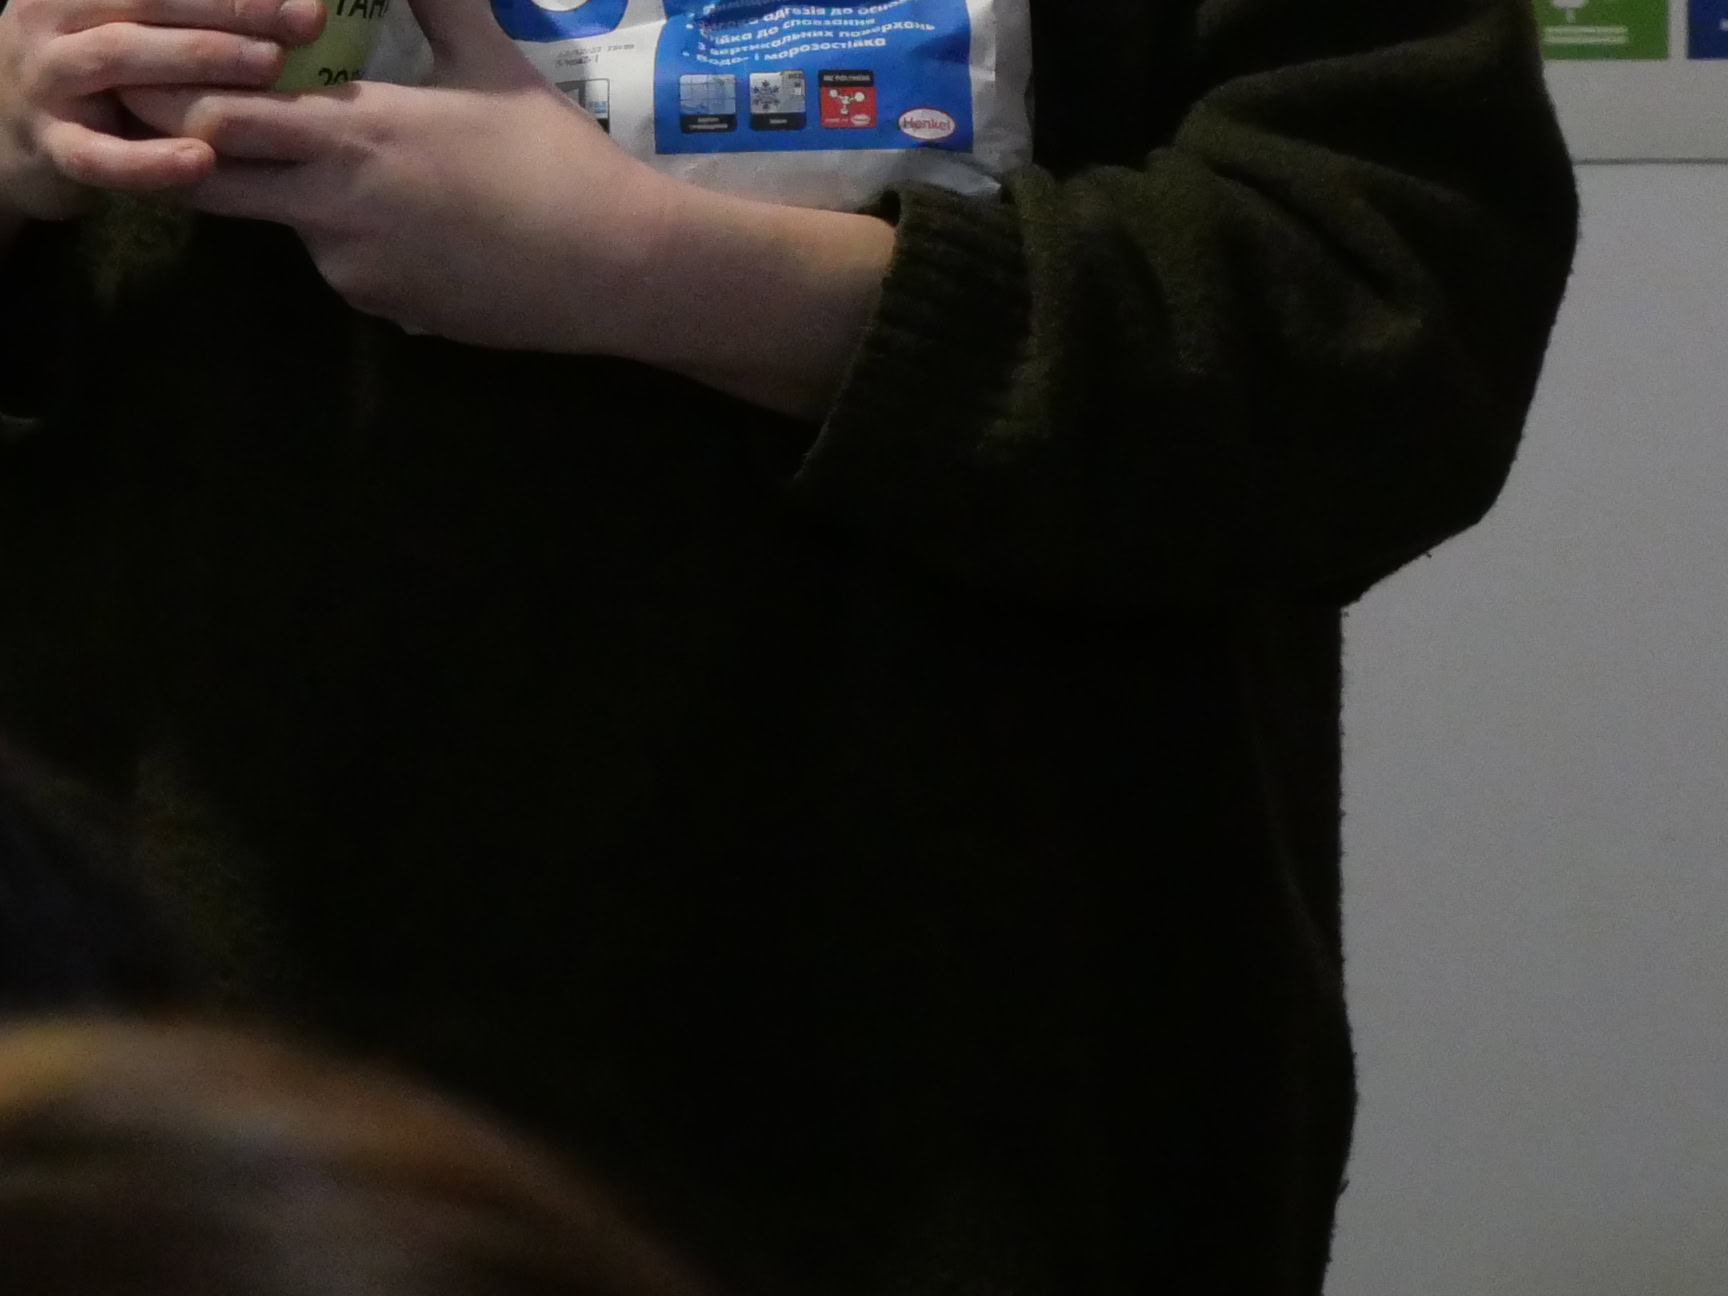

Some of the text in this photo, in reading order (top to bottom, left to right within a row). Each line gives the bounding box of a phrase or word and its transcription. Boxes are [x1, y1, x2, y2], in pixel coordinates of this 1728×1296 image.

[761, 5, 826, 22] адгезія
[829, 7, 854, 17] до
[709, 30, 835, 56] вертикальних
[838, 20, 936, 38] поверхонь
[756, 25, 780, 40] до
[782, 17, 876, 30] сповзання
[764, 37, 887, 62] морозостійка
[902, 116, 951, 132] Henkel
